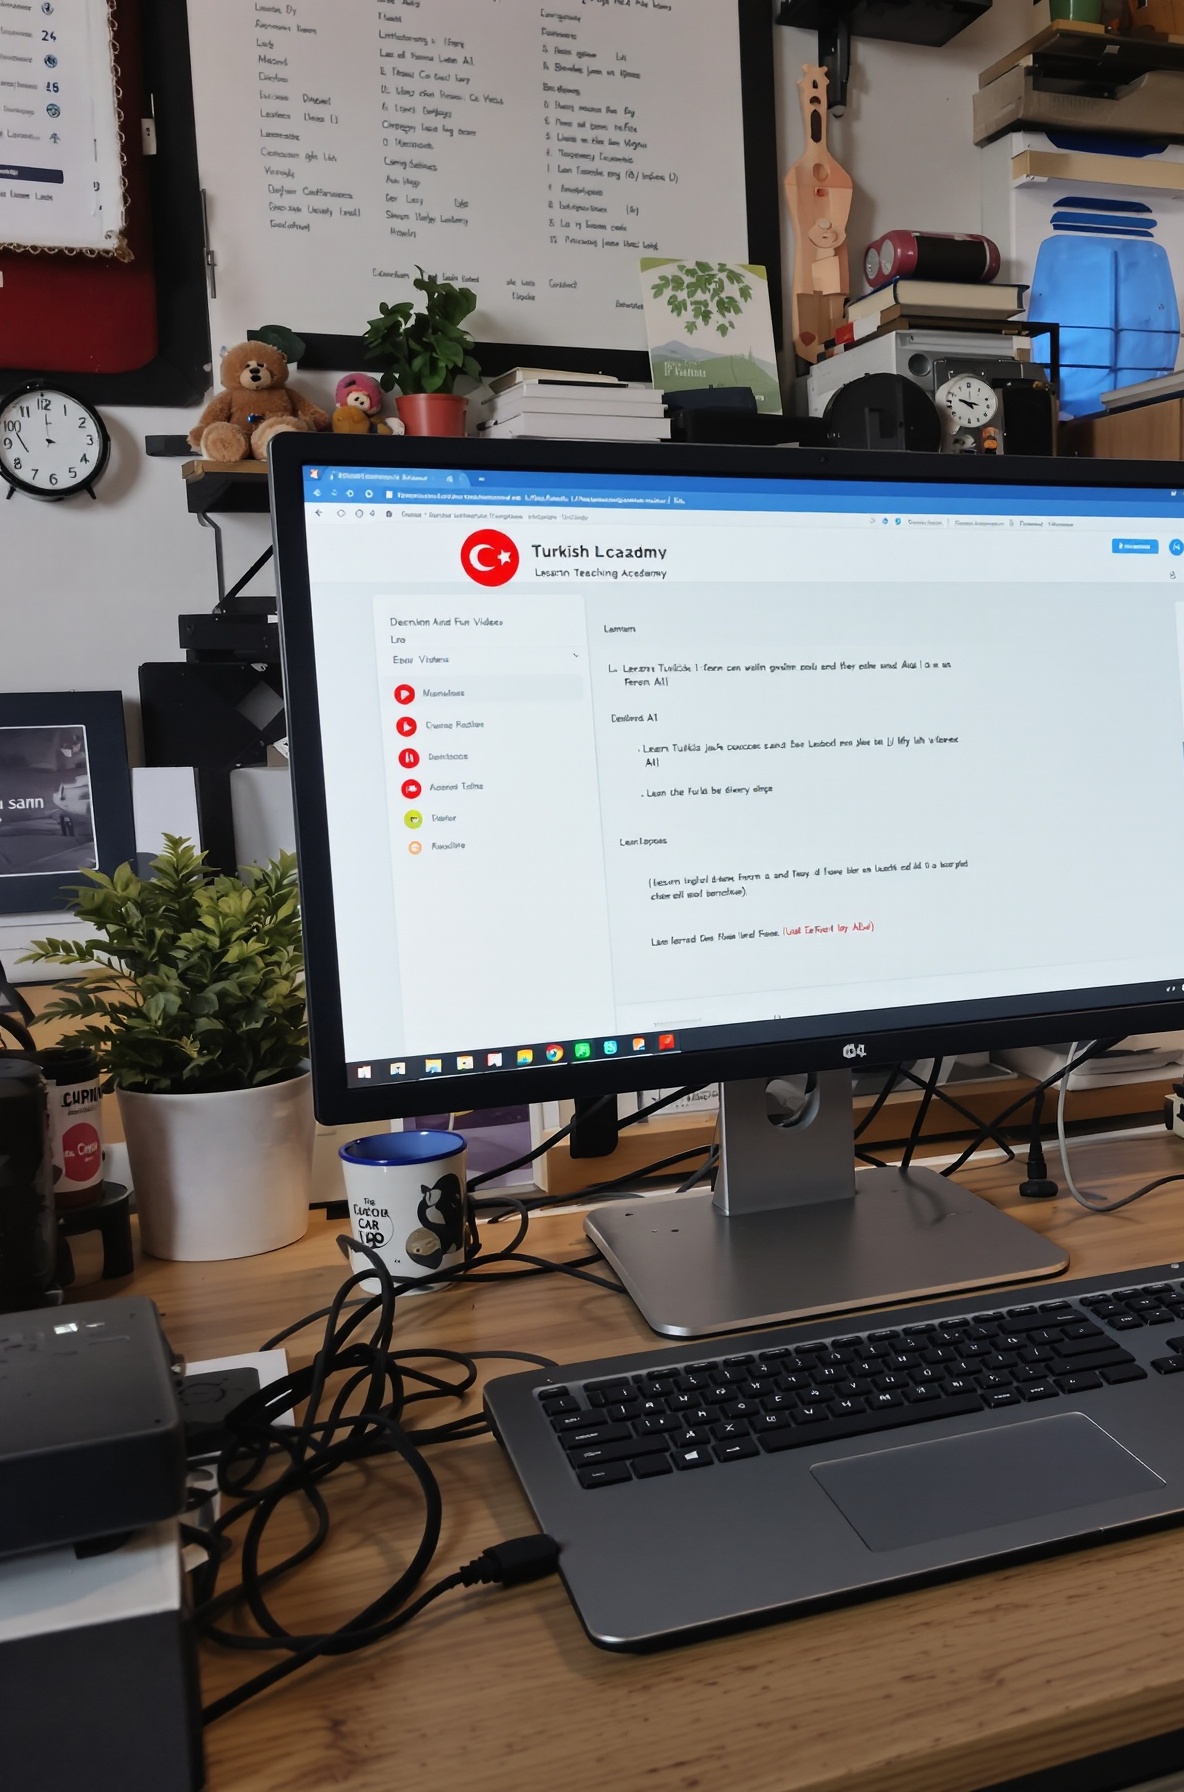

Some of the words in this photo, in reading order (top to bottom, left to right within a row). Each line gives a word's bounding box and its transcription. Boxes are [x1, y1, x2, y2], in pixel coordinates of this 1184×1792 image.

[78, 417, 87, 428] 2
[3, 437, 13, 450] 9
[86, 434, 94, 446] 3
[31, 468, 39, 480] 7
[68, 467, 77, 479] 5
[49, 473, 58, 486] 6
[531, 544, 590, 558] Turkish
[358, 1218, 380, 1231] CAR
